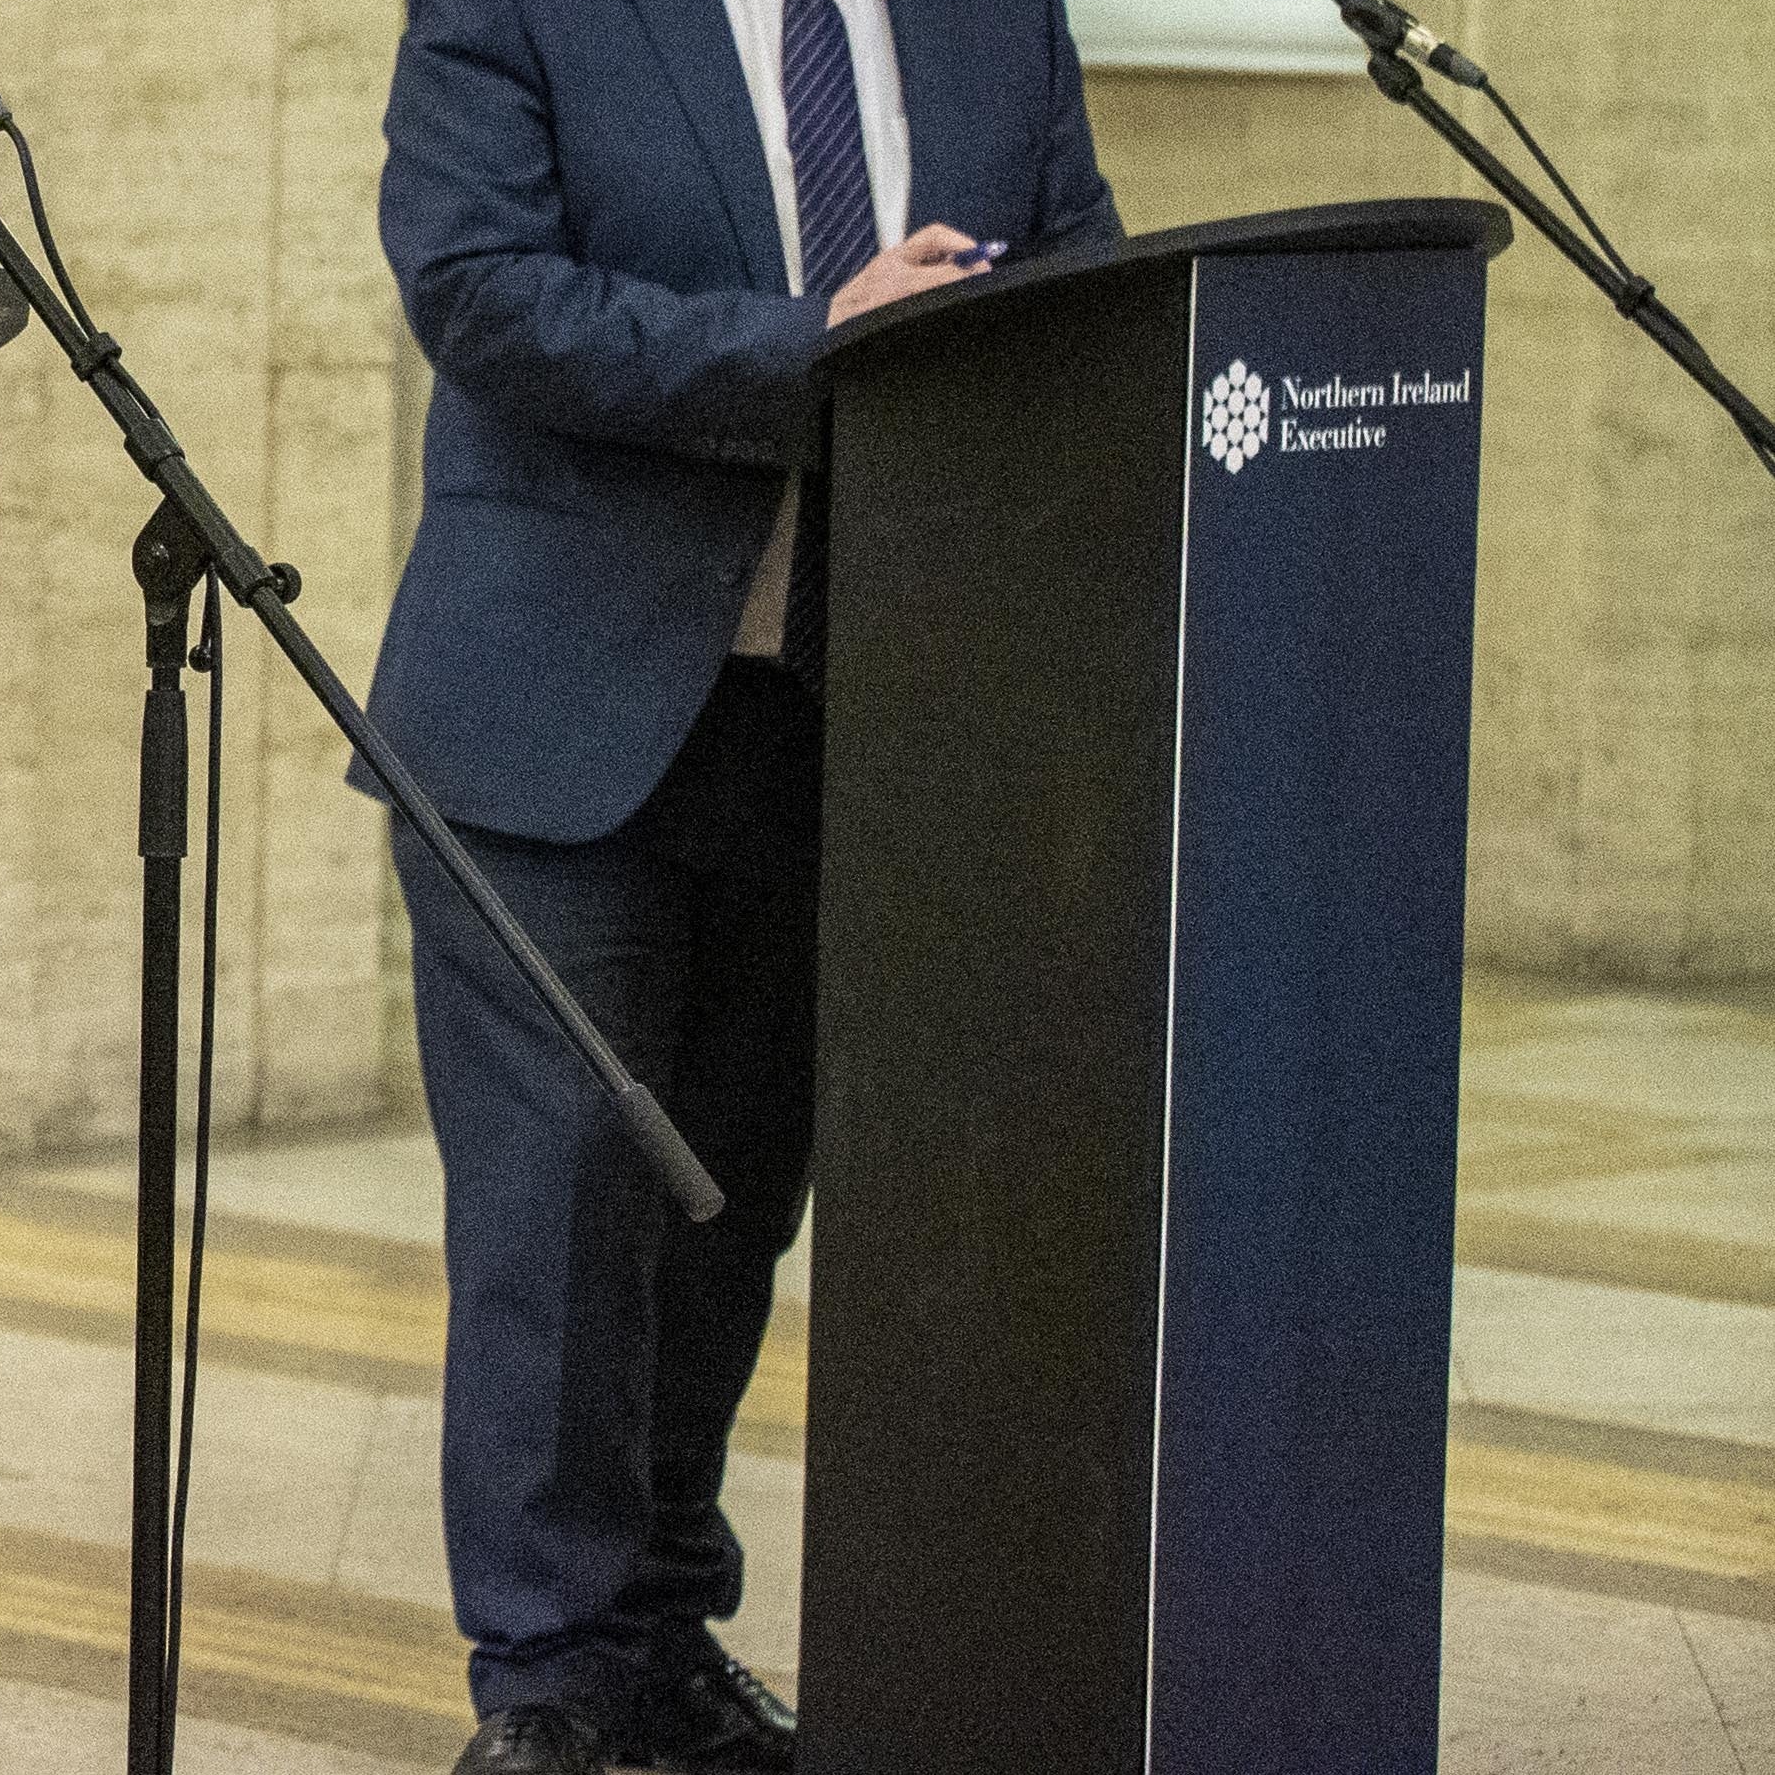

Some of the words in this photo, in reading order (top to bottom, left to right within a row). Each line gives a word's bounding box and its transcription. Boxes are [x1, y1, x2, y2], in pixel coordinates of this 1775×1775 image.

[1281, 375, 1385, 410] Northern
[1392, 368, 1470, 406] Ireland
[1280, 416, 1387, 453] Executive
